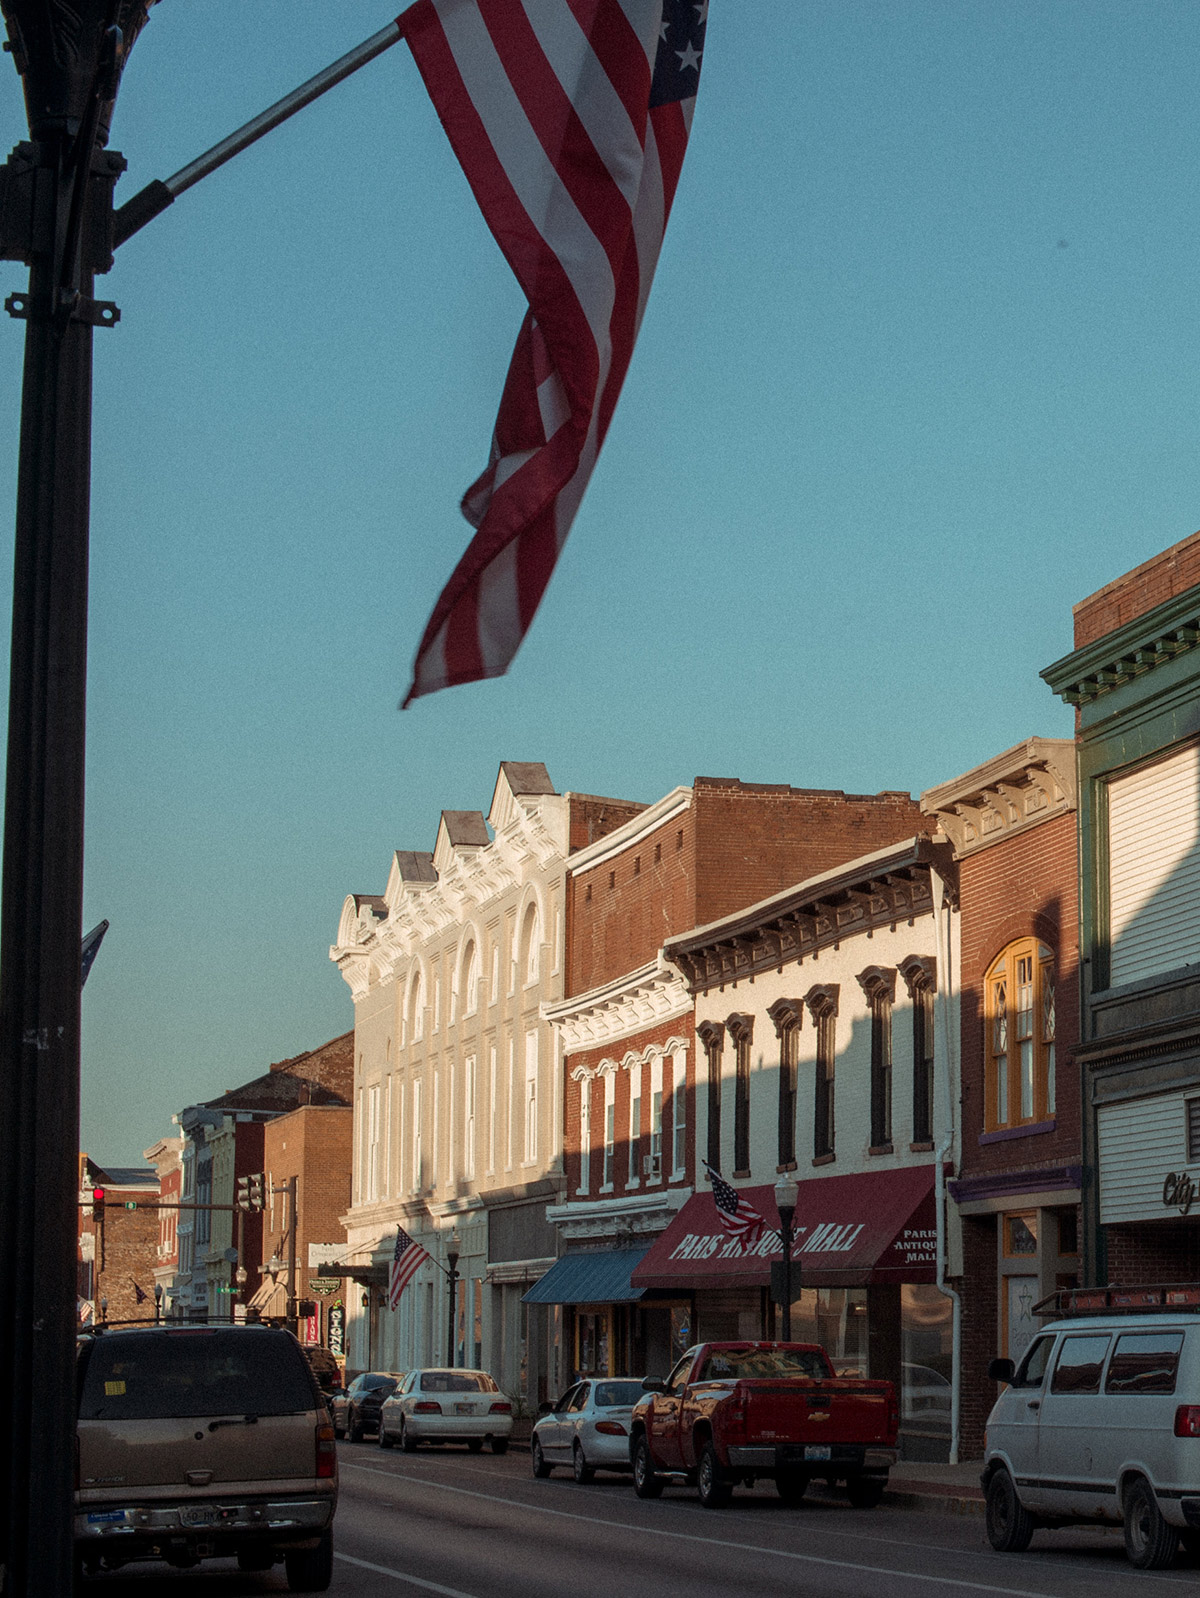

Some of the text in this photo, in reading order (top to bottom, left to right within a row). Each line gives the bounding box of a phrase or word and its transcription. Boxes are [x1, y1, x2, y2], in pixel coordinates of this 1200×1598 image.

[1163, 1172, 1196, 1215] City
[668, 1233, 725, 1260] PARIS
[792, 1222, 866, 1258] MALL
[893, 1241, 938, 1251] ANTIQU
[904, 1229, 938, 1239] PARIS
